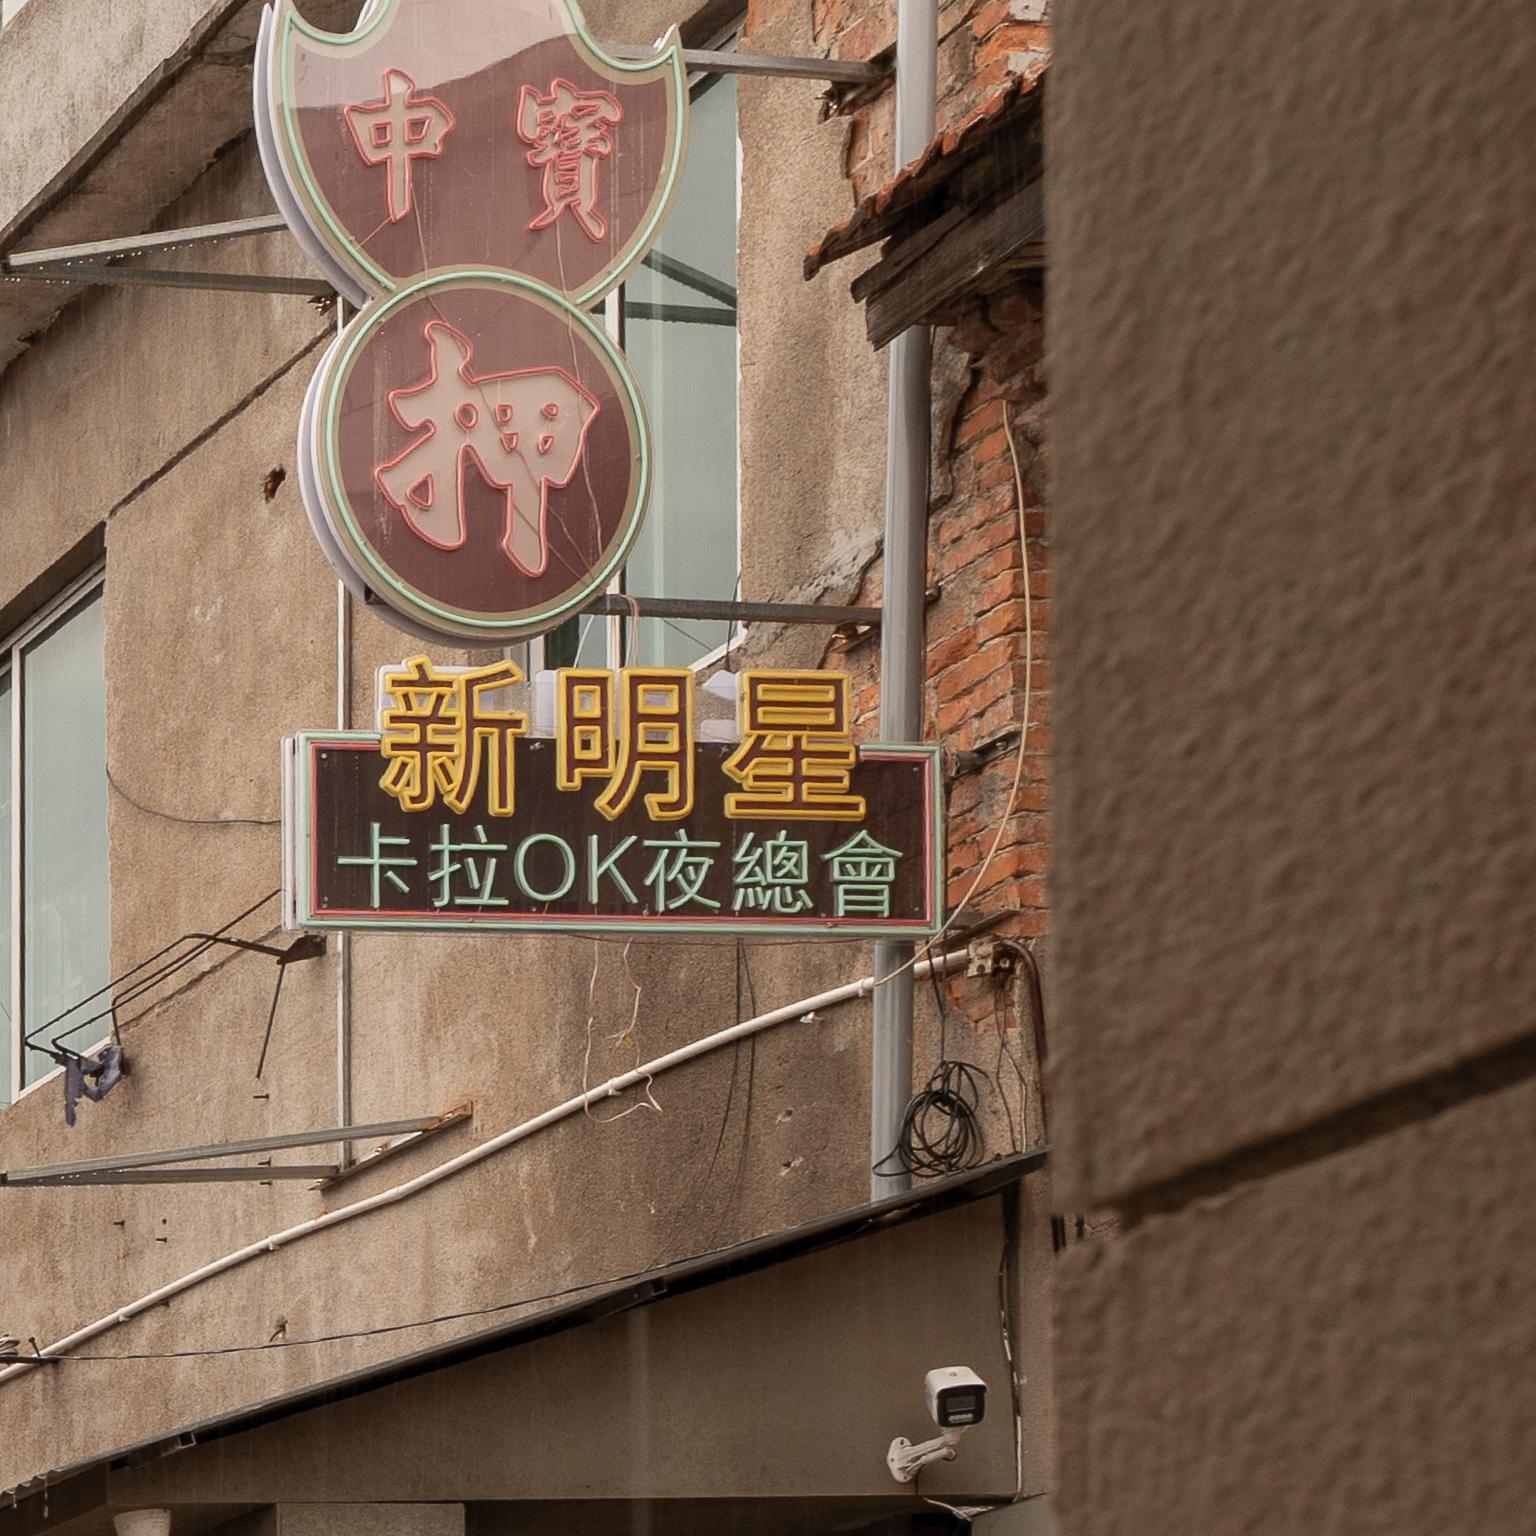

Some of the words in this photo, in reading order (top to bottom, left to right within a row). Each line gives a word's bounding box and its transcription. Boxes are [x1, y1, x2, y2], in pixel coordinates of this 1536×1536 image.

[374, 321, 600, 578] 押
[378, 656, 866, 822] 新明星
[336, 821, 903, 918] 卡拉OK夜總會
